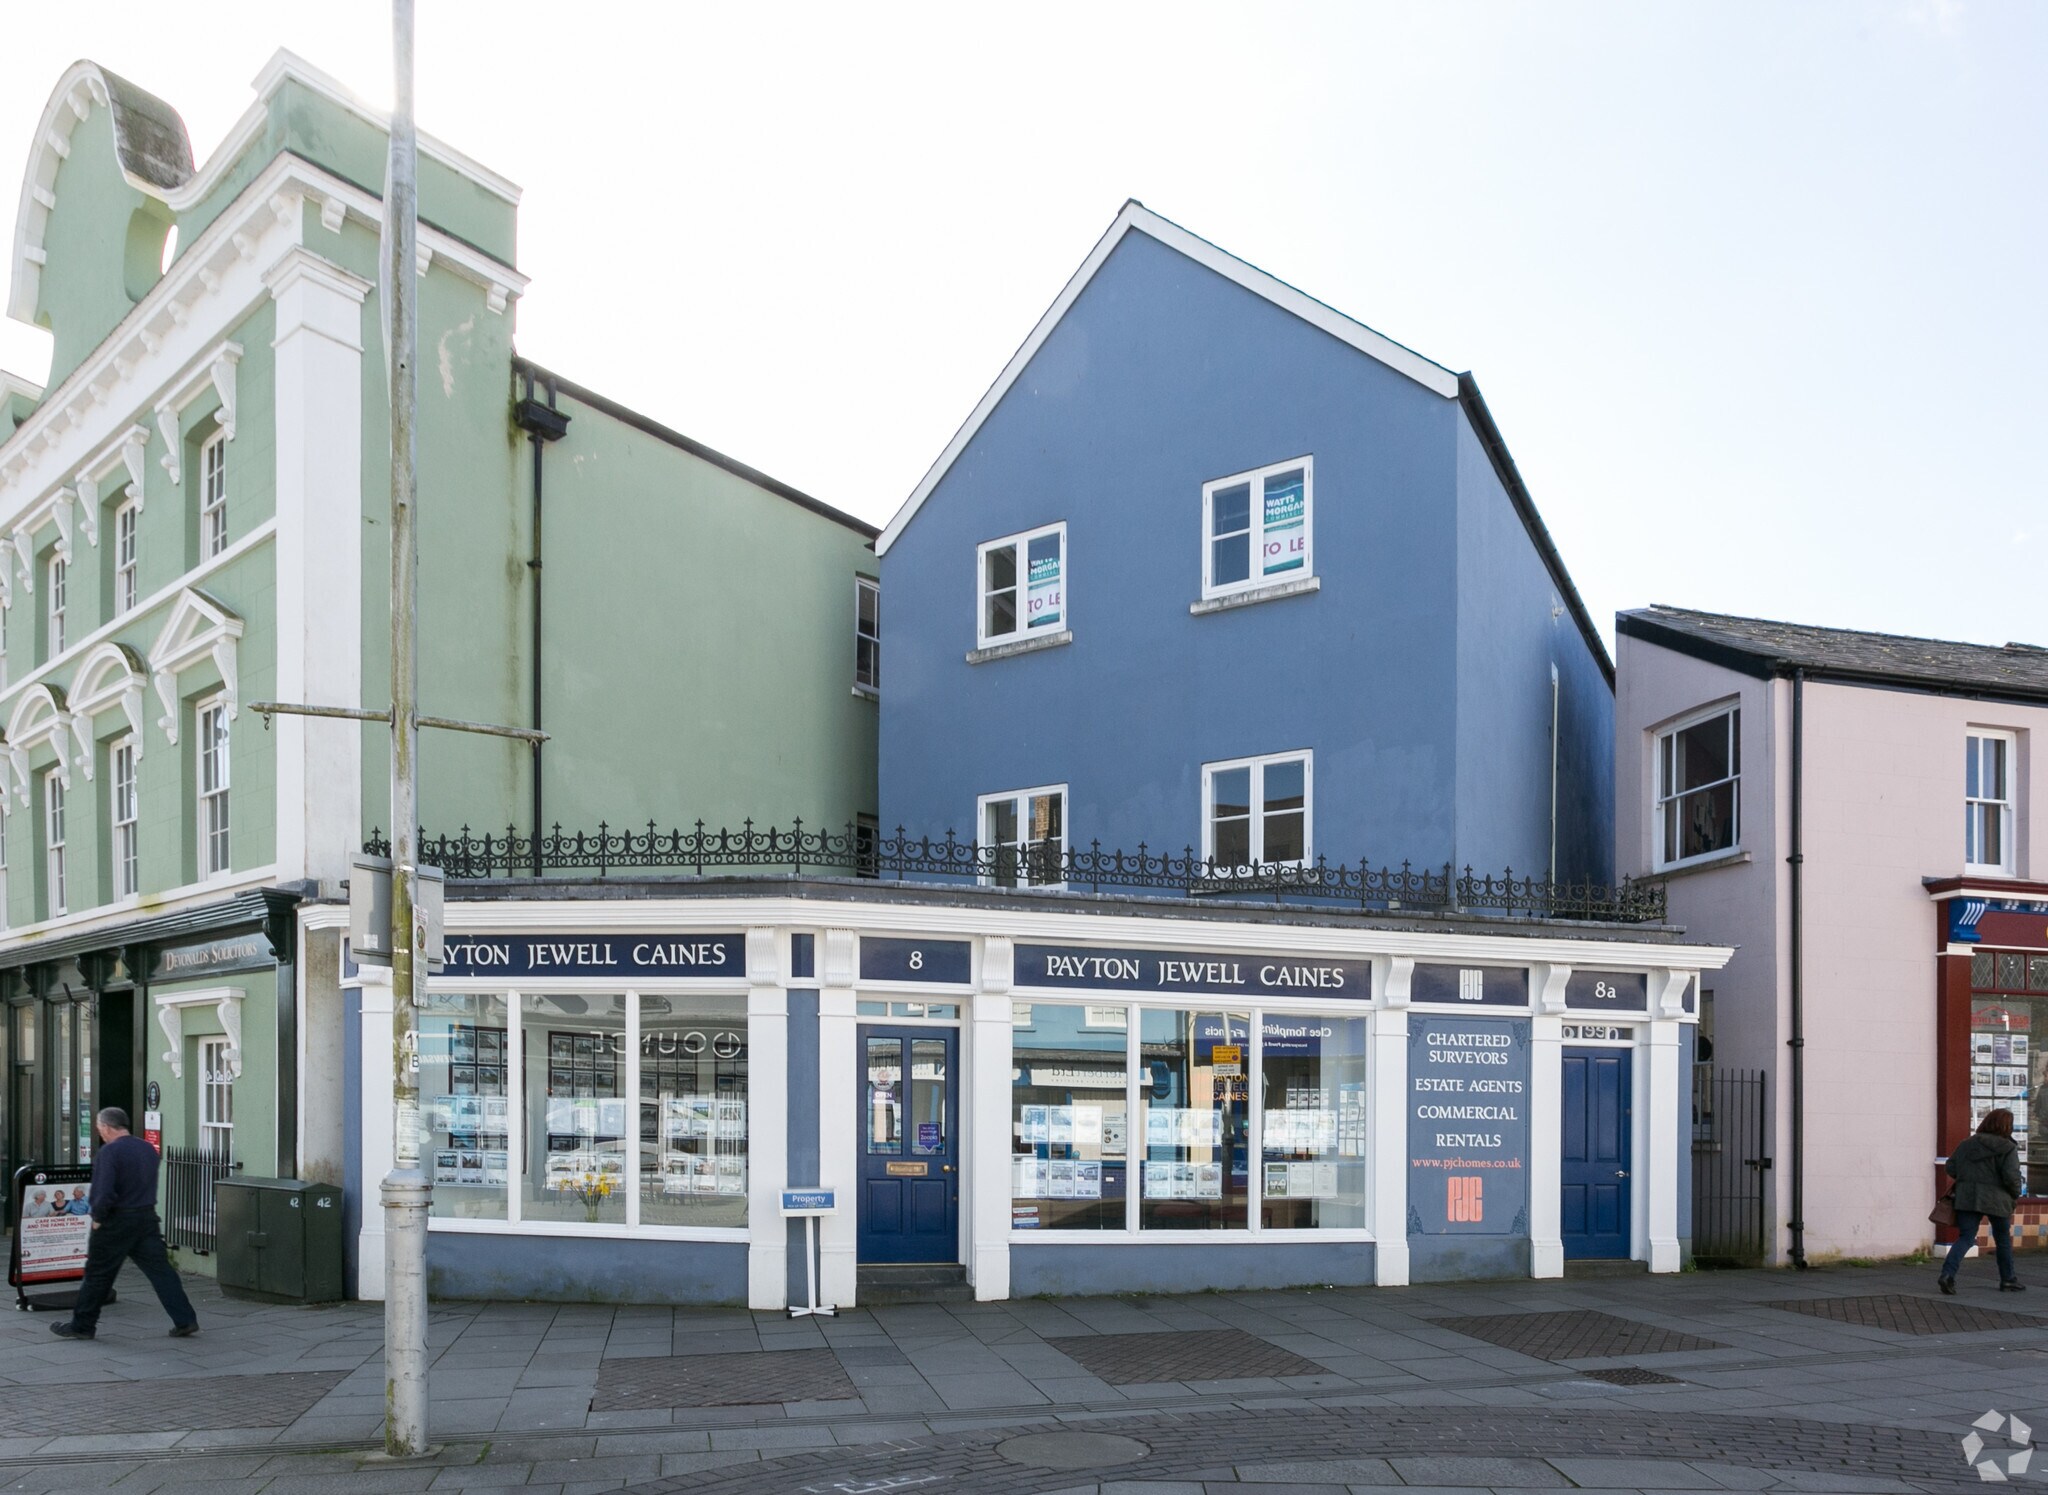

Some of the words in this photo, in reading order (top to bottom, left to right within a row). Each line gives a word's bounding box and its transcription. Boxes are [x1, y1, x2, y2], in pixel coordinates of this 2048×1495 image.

[1266, 494, 1295, 508] WATTS
[1263, 542, 1282, 557] TO
[1028, 598, 1043, 612] TO
[211, 942, 257, 964] SOLICITORS
[527, 943, 618, 969] JEWELL
[632, 943, 726, 966] CAINES
[909, 950, 923, 970] 8
[1046, 955, 1140, 980] PAYTON
[1158, 960, 1245, 985] JEWELL
[1260, 965, 1344, 988] CAINES
[1595, 981, 1617, 999] 8a
[1426, 1033, 1511, 1047] CHARTERED
[1429, 1050, 1509, 1065] SURVEYORS
[1415, 1078, 1464, 1092] ESTATE
[1468, 1080, 1523, 1093] AGENTS
[1417, 1105, 1518, 1120] COMMERCIAL
[1436, 1133, 1502, 1147] RENTALS
[1412, 1157, 1521, 1170] www.pjchomes.co.uk
[290, 1197, 299, 1208] 42
[317, 1197, 332, 1208] 42
[792, 1195, 826, 1204] Property
